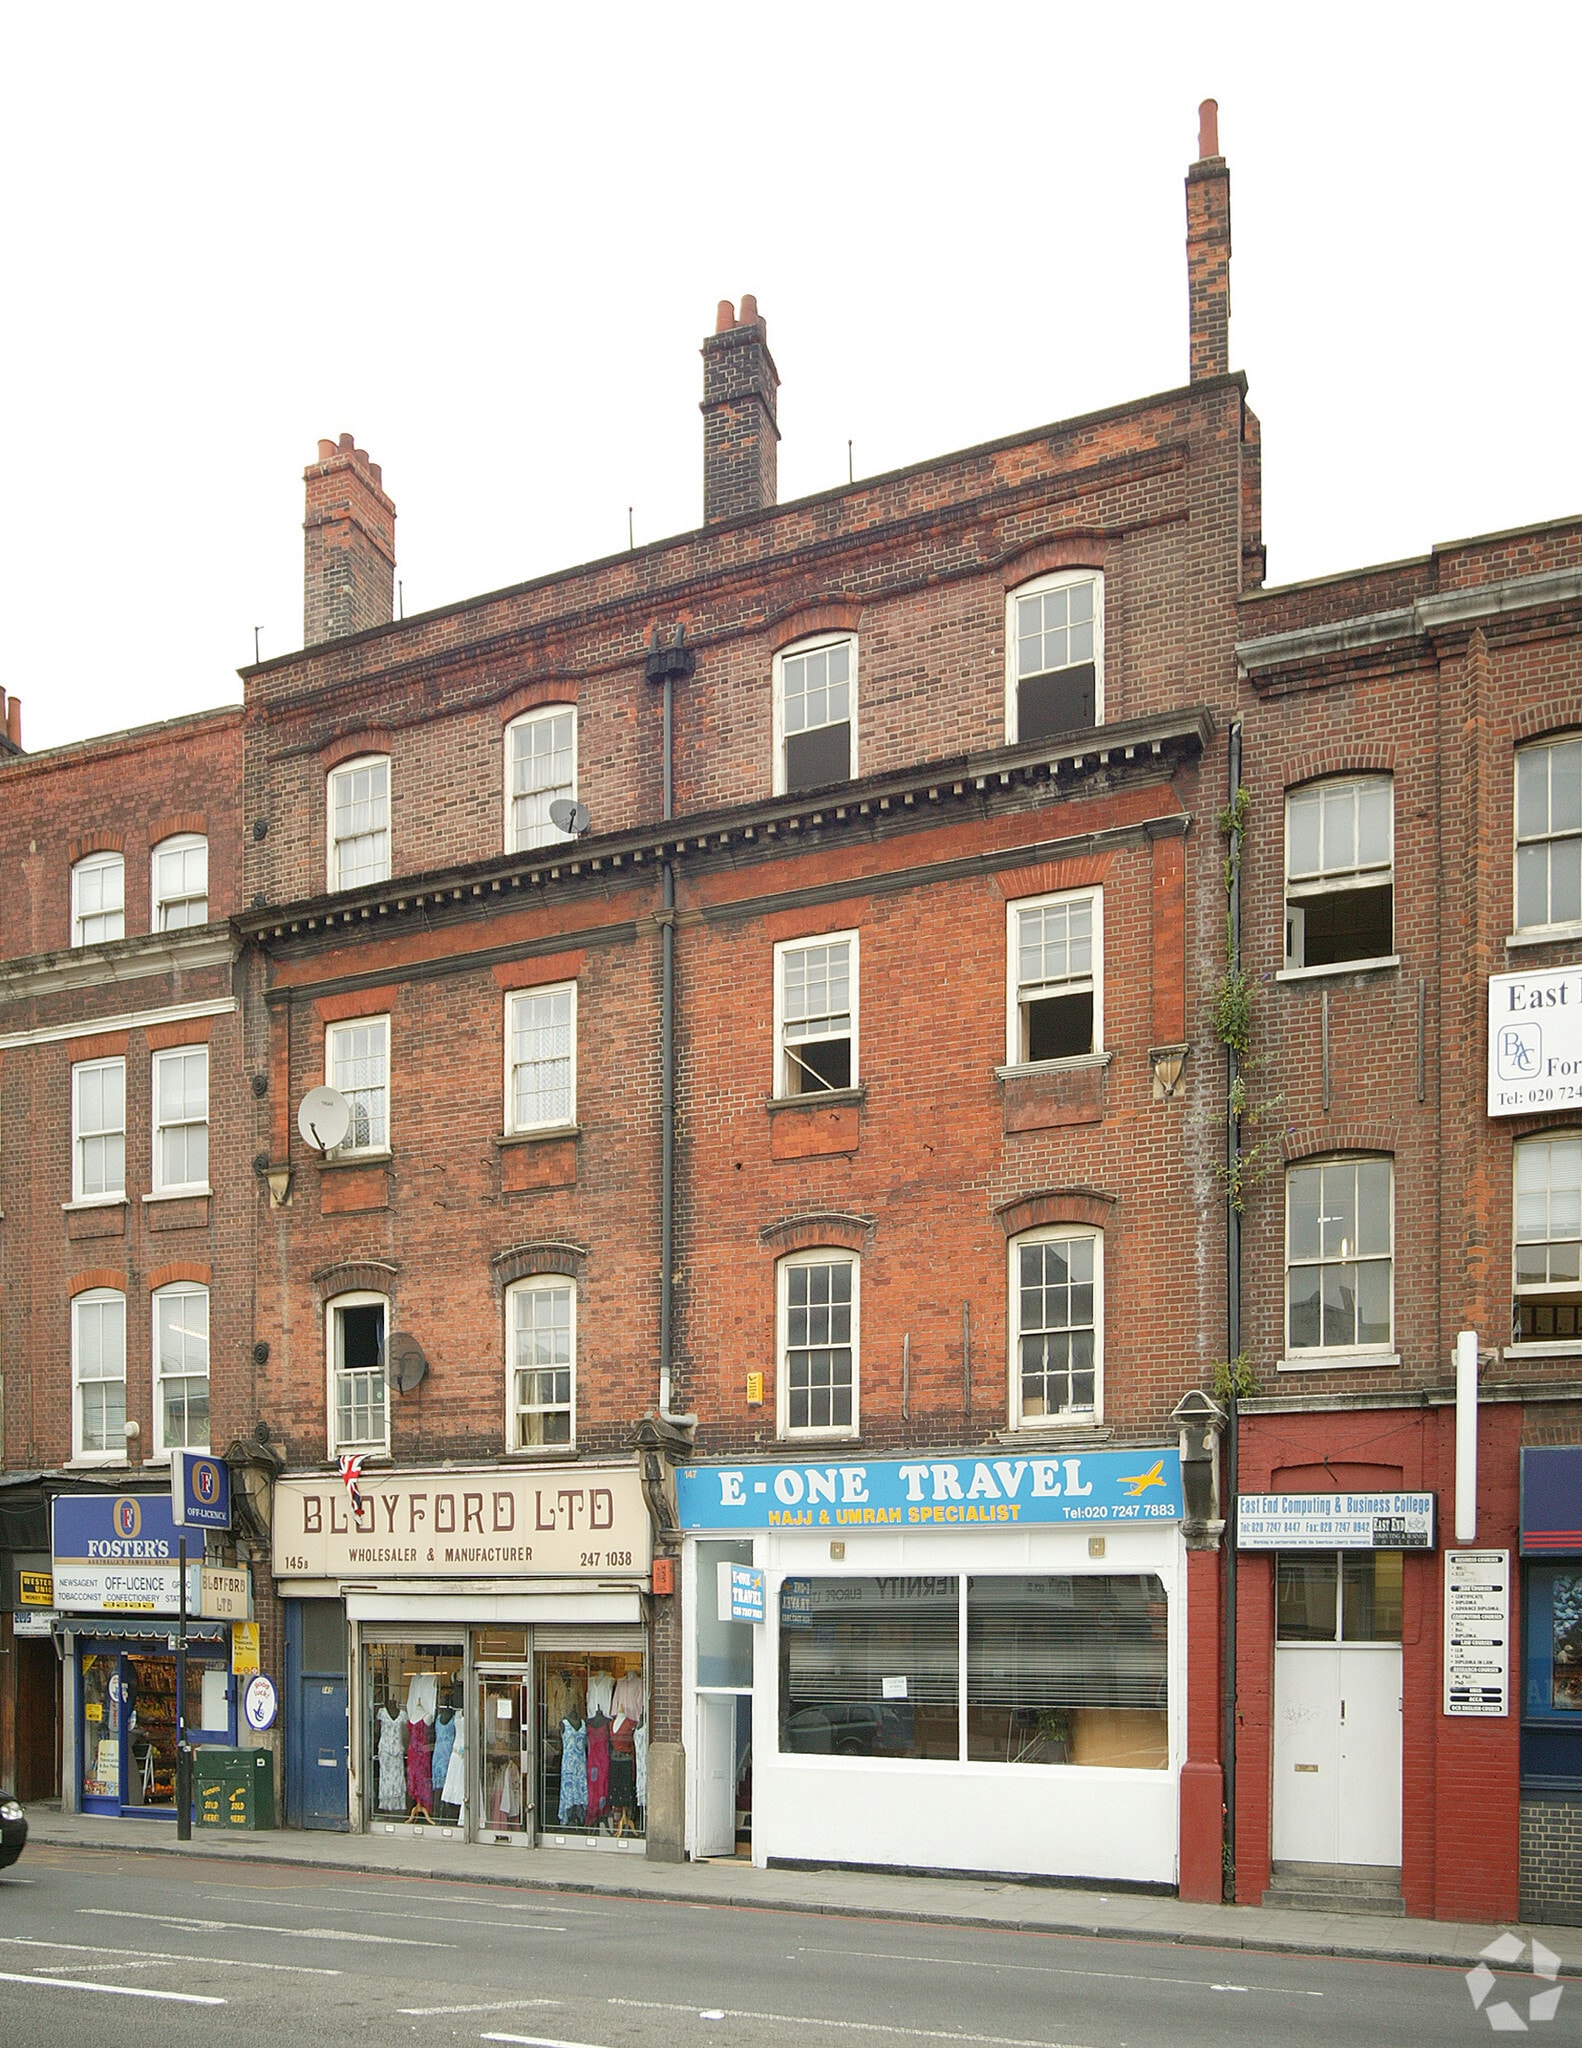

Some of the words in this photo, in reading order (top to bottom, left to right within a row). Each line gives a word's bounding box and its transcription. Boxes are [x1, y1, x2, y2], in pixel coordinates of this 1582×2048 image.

[1507, 981, 1568, 1012] East
[1497, 1091, 1523, 1105] Tel:
[1528, 1088, 1553, 1103] 020
[899, 1459, 1092, 1500] TRAVEL
[187, 1507, 226, 1520] OFF-LICENCE
[303, 1491, 515, 1534] BLOYFORD
[535, 1488, 613, 1531] LTD
[1112, 1505, 1139, 1518] 7247
[1144, 1503, 1175, 1516] 7883
[1240, 1497, 1259, 1513] East
[1262, 1497, 1278, 1513] End
[1282, 1496, 1331, 1516] Computing
[1334, 1496, 1341, 1513] &
[1347, 1496, 1390, 1513] Business
[1394, 1495, 1430, 1515] College
[768, 1510, 812, 1526] HAJJ
[819, 1509, 830, 1524] &
[836, 1506, 901, 1525] UMRAH
[908, 1504, 1021, 1522] SPECIALIST
[1266, 1522, 1281, 1533] 7247
[1284, 1522, 1300, 1533] 8447
[1334, 1522, 1350, 1533] 7247
[1373, 1518, 1390, 1532] EAST
[1391, 1518, 1405, 1532] END
[88, 1539, 169, 1558] FOSTER'S
[349, 1548, 417, 1562] WHOLESALER
[426, 1547, 435, 1562] &
[445, 1546, 533, 1562] MANUFACTURER
[580, 1552, 600, 1567] 247
[605, 1551, 632, 1566] 1038
[23, 1577, 52, 1586] WESTER
[59, 1579, 98, 1588] NEWSAGENT
[105, 1576, 164, 1591] OFF-LICENCE
[58, 1592, 102, 1602] TOBACCONIST
[106, 1593, 160, 1603] CONFECTIONERY
[216, 1597, 232, 1612] LTD
[731, 1587, 762, 1606] TRAVEL
